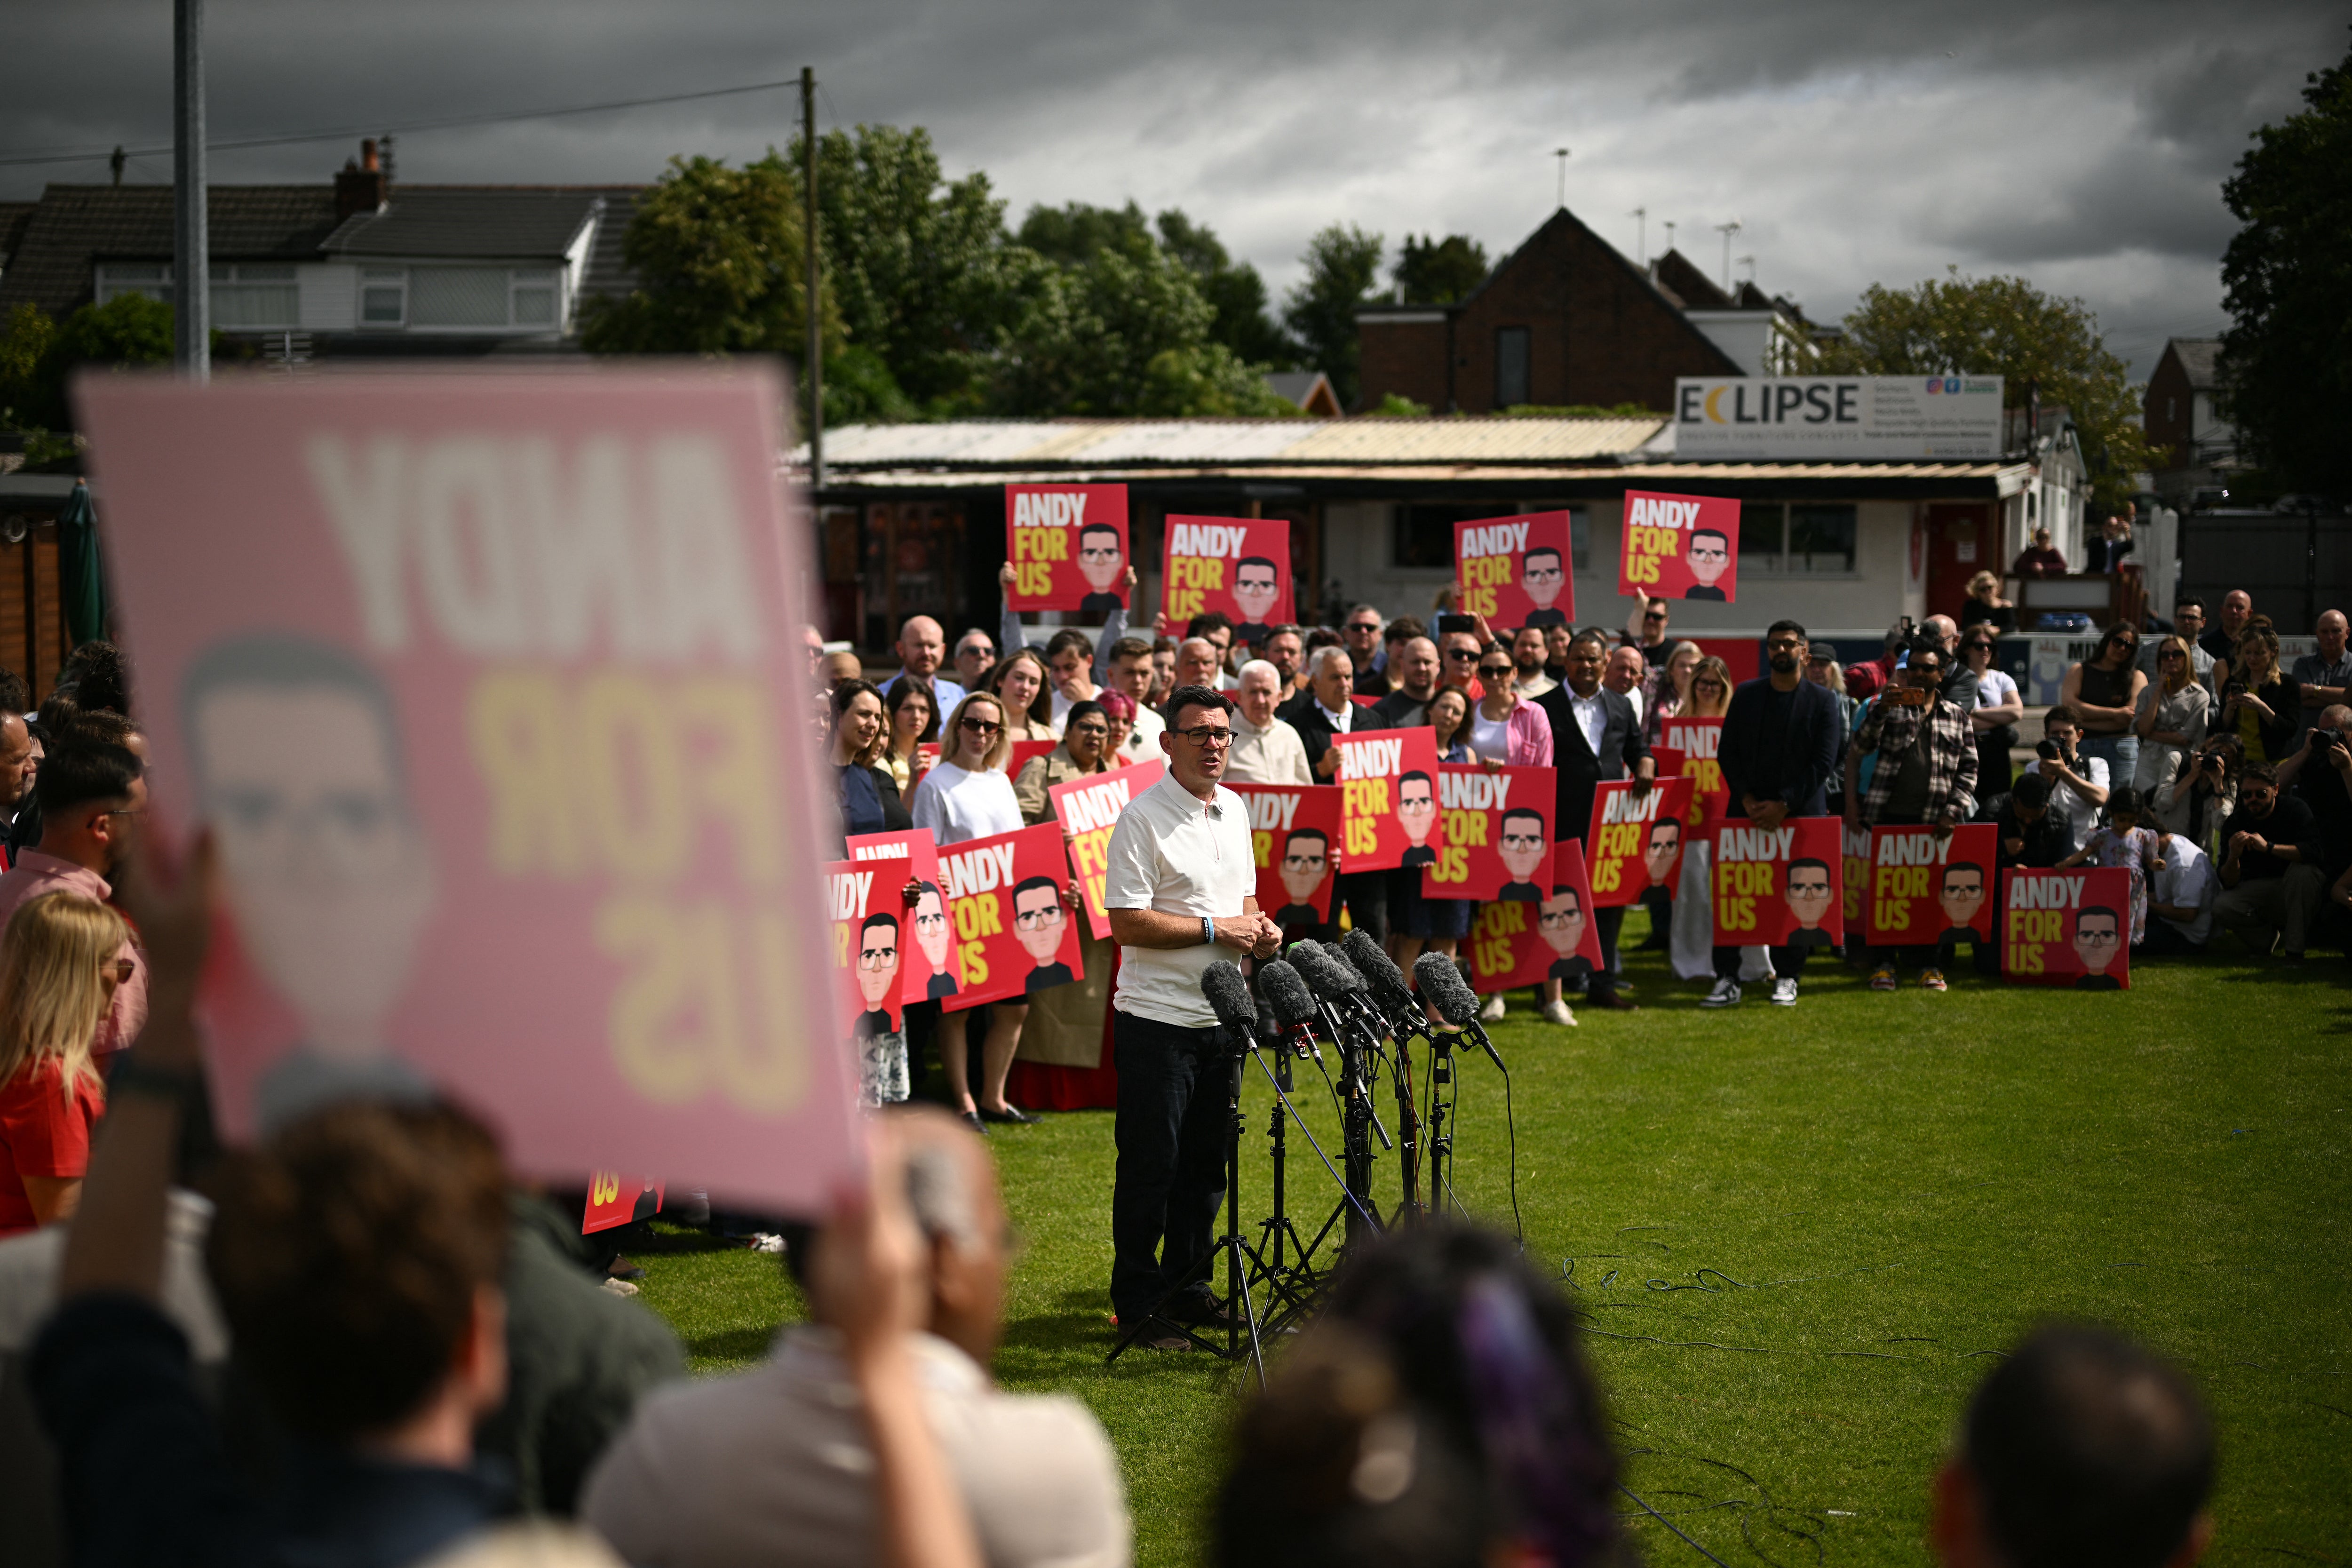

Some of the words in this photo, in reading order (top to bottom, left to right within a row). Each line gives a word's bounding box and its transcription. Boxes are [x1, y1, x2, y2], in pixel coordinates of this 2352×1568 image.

[1014, 493, 1087, 526] ANDY
[1629, 498, 1700, 530] ANDY
[1014, 527, 1069, 561] FOR
[1170, 524, 1247, 558] ANDY
[1462, 522, 1530, 558] ANDY
[1628, 526, 1679, 557] FOR
[1016, 562, 1052, 597] US
[1168, 557, 1224, 590] FOR
[1462, 556, 1512, 588] FOR
[1626, 555, 1661, 584] US
[1168, 589, 1205, 621] US
[1464, 588, 1498, 617] US
[1341, 738, 1402, 780] ANDY
[1668, 725, 1721, 759] AND
[1439, 772, 1512, 810] ANDY
[1683, 759, 1721, 792] OR
[1241, 792, 1302, 831] NDY
[1343, 779, 1390, 817] FOR
[1601, 787, 1664, 825] ANDY
[1689, 791, 1703, 827] S
[1074, 825, 1117, 877] FO
[1344, 817, 1377, 855] US
[1597, 823, 1642, 859] FOR
[1718, 827, 1796, 862] ANDY
[1878, 833, 1954, 866] ANDY
[1593, 858, 1624, 893] US
[1718, 862, 1774, 896] FOR
[1876, 866, 1929, 899] FOR
[2009, 876, 2086, 909] ANDY
[824, 871, 874, 921] NDY
[1086, 874, 1109, 918] U
[948, 892, 1003, 941] OR
[1719, 897, 1757, 932] US
[1875, 899, 1911, 931] US
[2009, 910, 2063, 942] FOR
[1475, 938, 1515, 977] US
[2009, 943, 2045, 976] US
[594, 1167, 620, 1207] US
